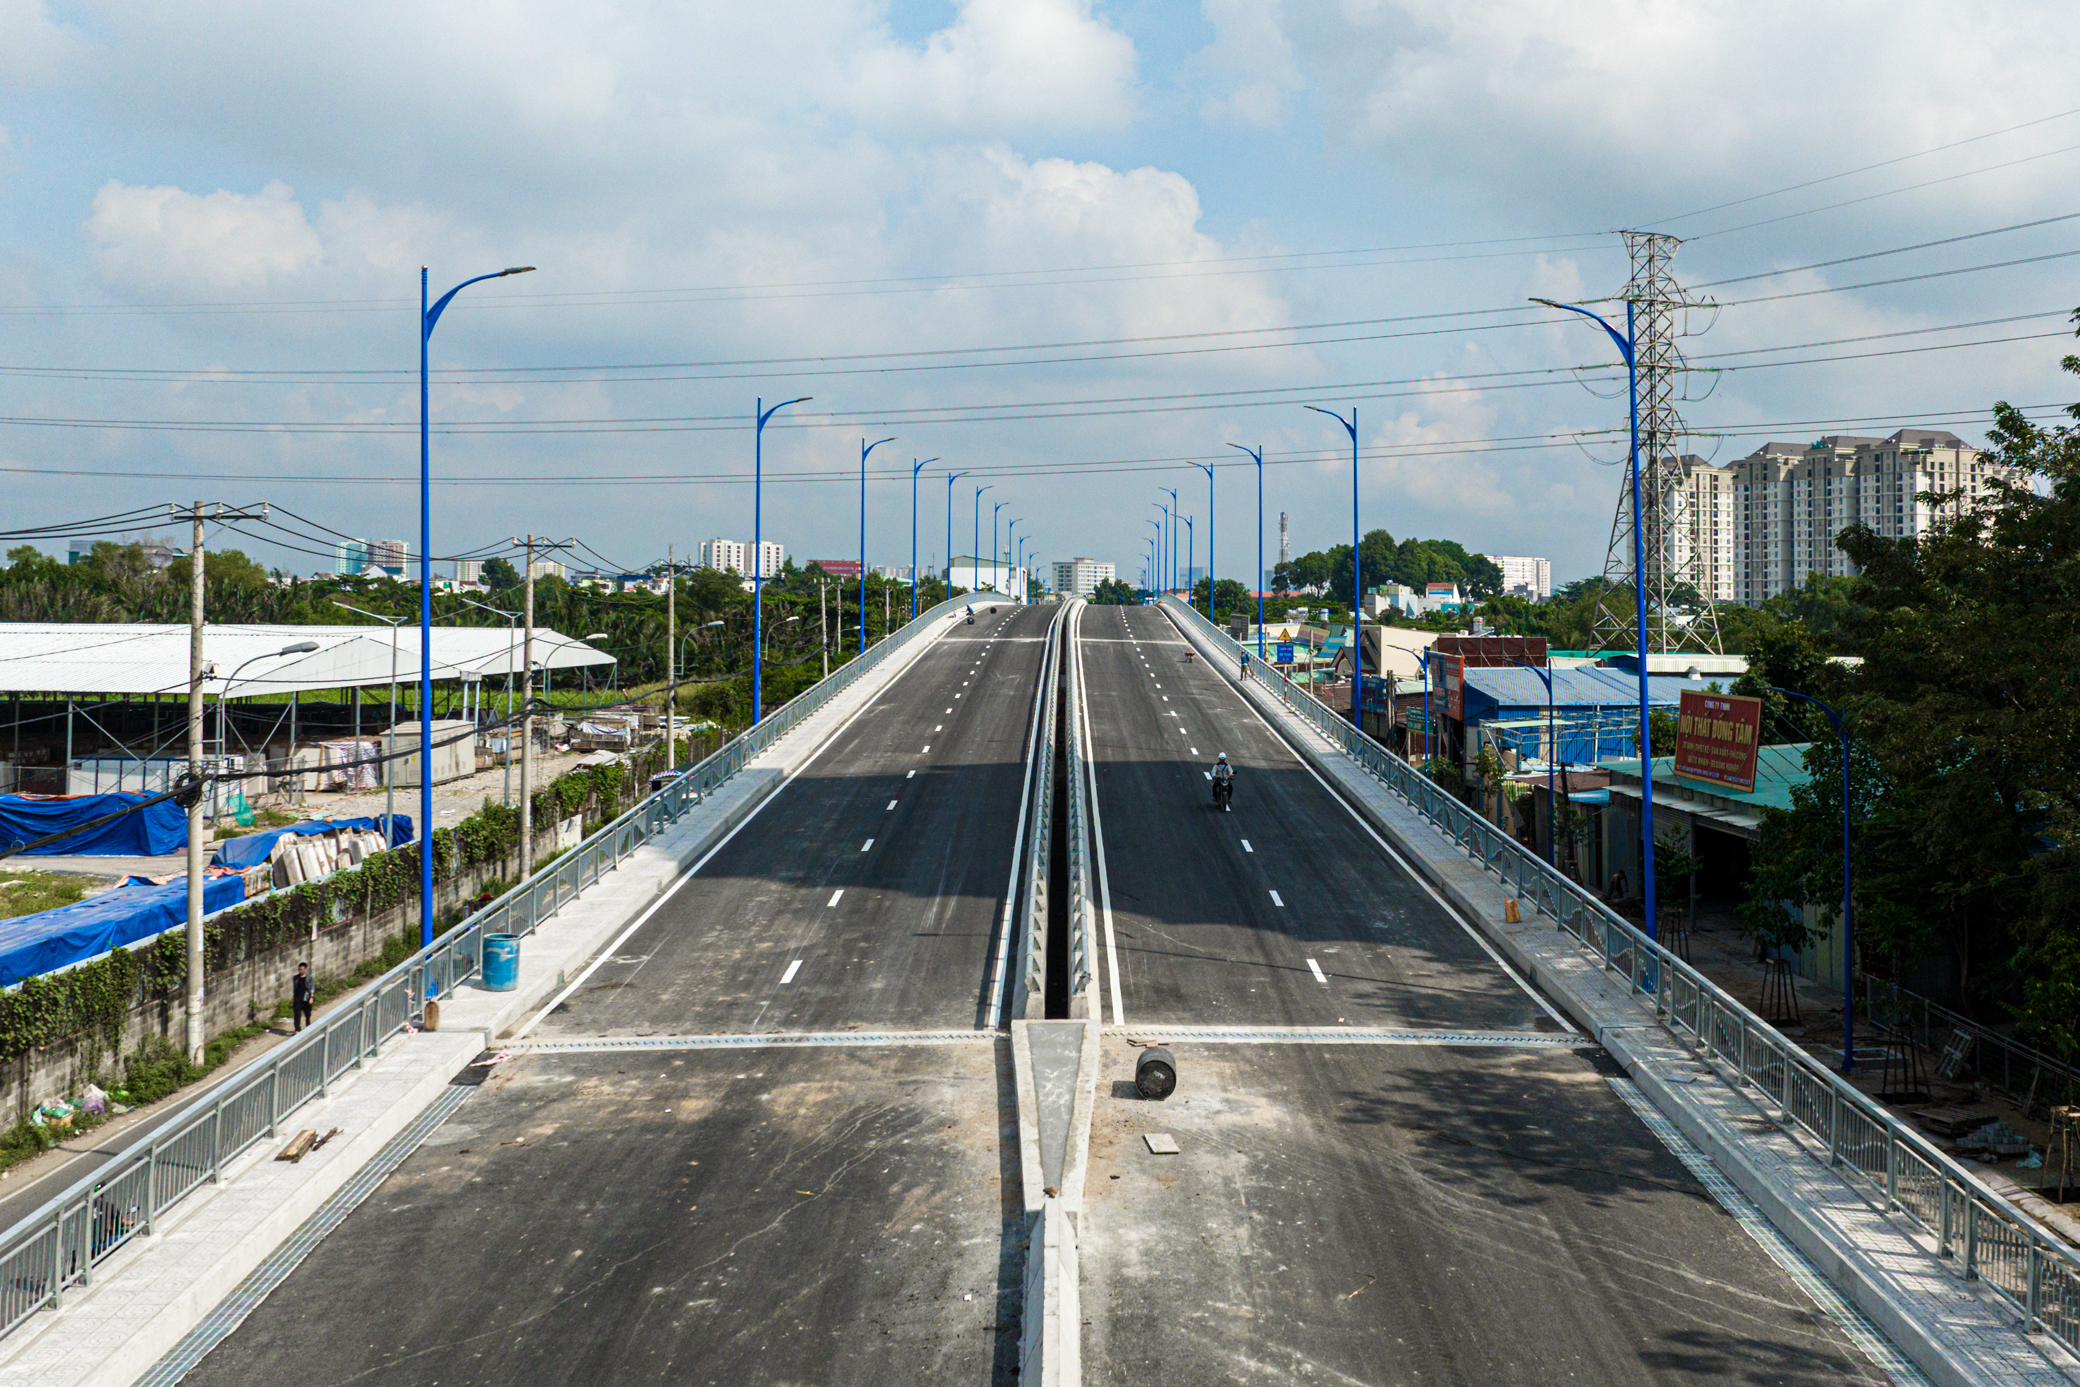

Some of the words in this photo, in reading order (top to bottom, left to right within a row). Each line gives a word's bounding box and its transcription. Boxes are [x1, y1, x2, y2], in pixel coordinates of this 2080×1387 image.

[1680, 710, 1693, 738] NỘI
[1694, 711, 1712, 737] THẤT
[1736, 718, 1753, 745] TÂM
